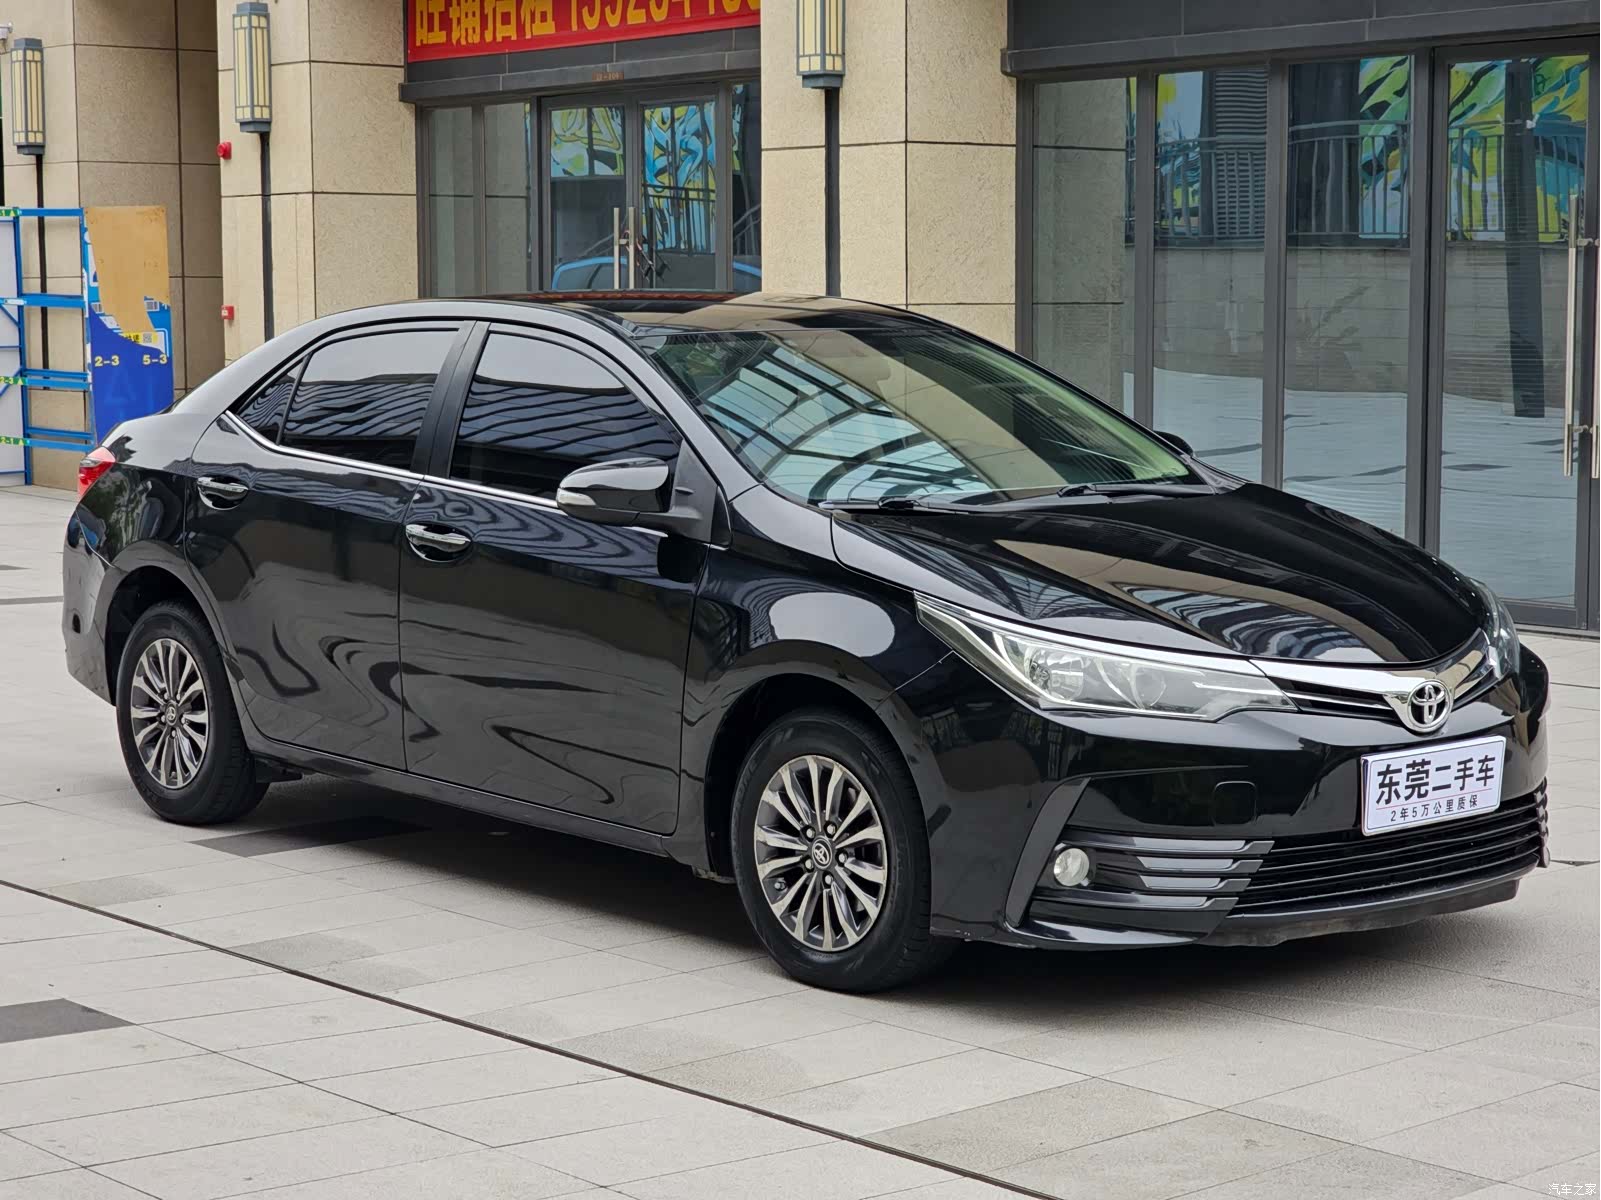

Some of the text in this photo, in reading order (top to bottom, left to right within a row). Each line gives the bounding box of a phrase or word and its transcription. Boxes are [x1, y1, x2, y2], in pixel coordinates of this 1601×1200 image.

[94, 355, 120, 367] 2-3
[142, 354, 168, 365] 5-3
[1376, 755, 1496, 805] 东莞二手车
